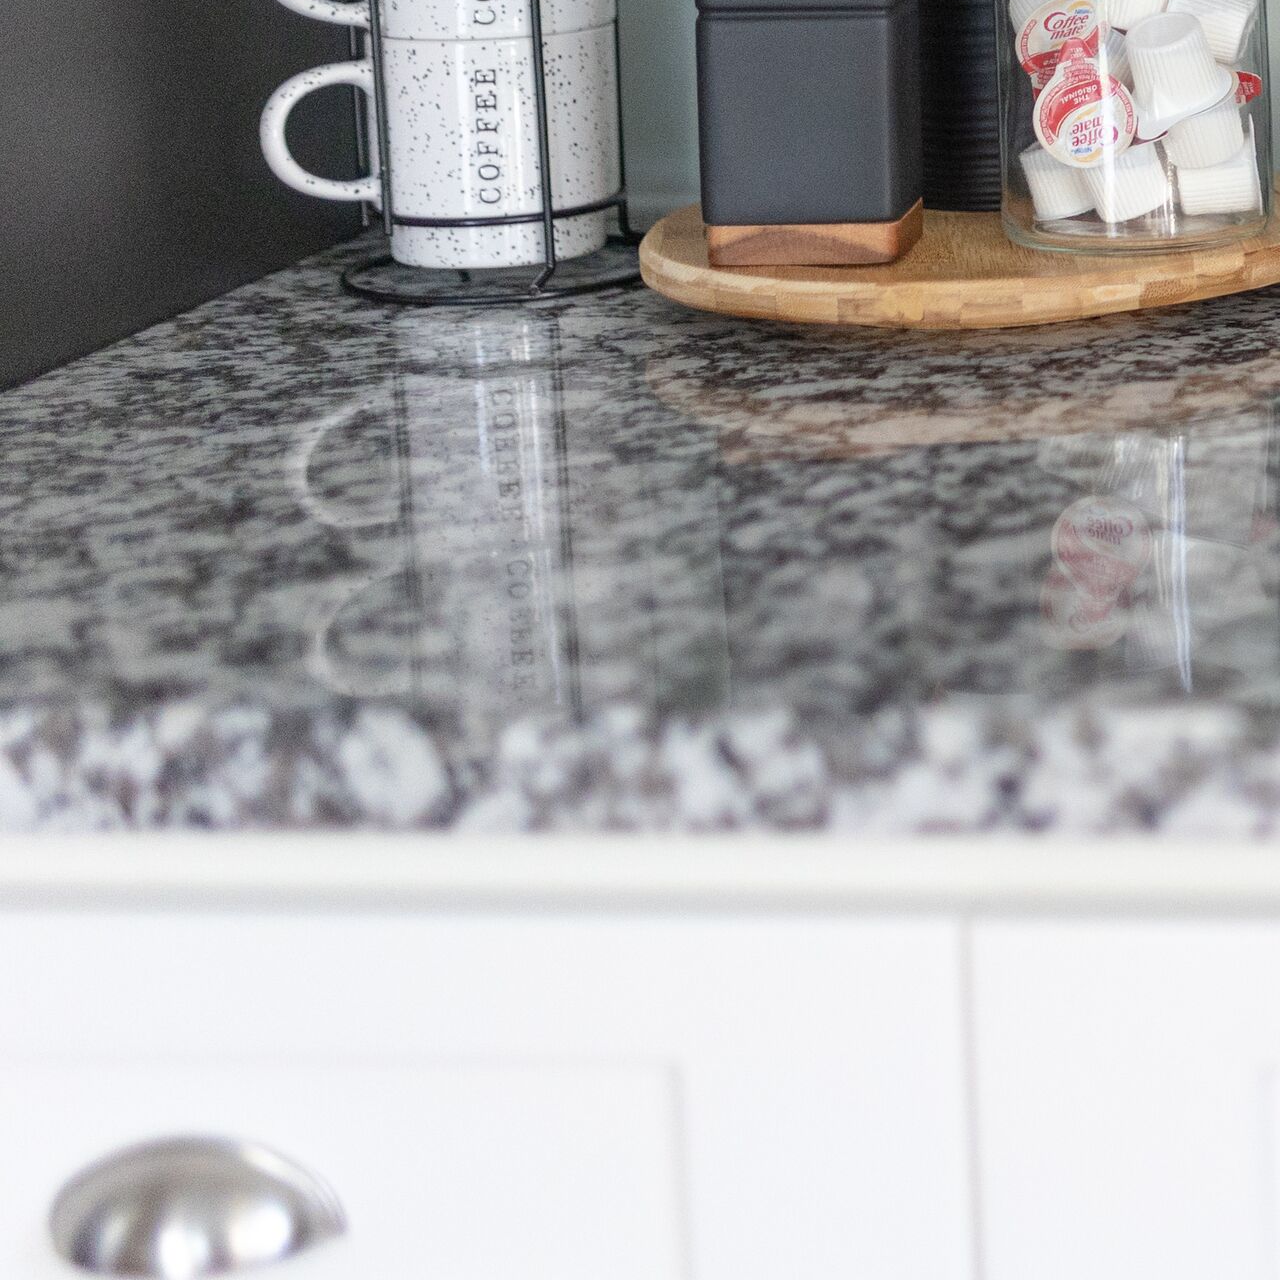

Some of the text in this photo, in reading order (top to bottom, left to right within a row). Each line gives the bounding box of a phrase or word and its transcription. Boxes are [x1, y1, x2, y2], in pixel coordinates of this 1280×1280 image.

[1043, 11, 1090, 32] Coffee
[1050, 24, 1084, 40] mate
[1060, 84, 1098, 105] ORIGINAL
[1073, 94, 1090, 105] THE
[473, 67, 501, 206] COFFEE
